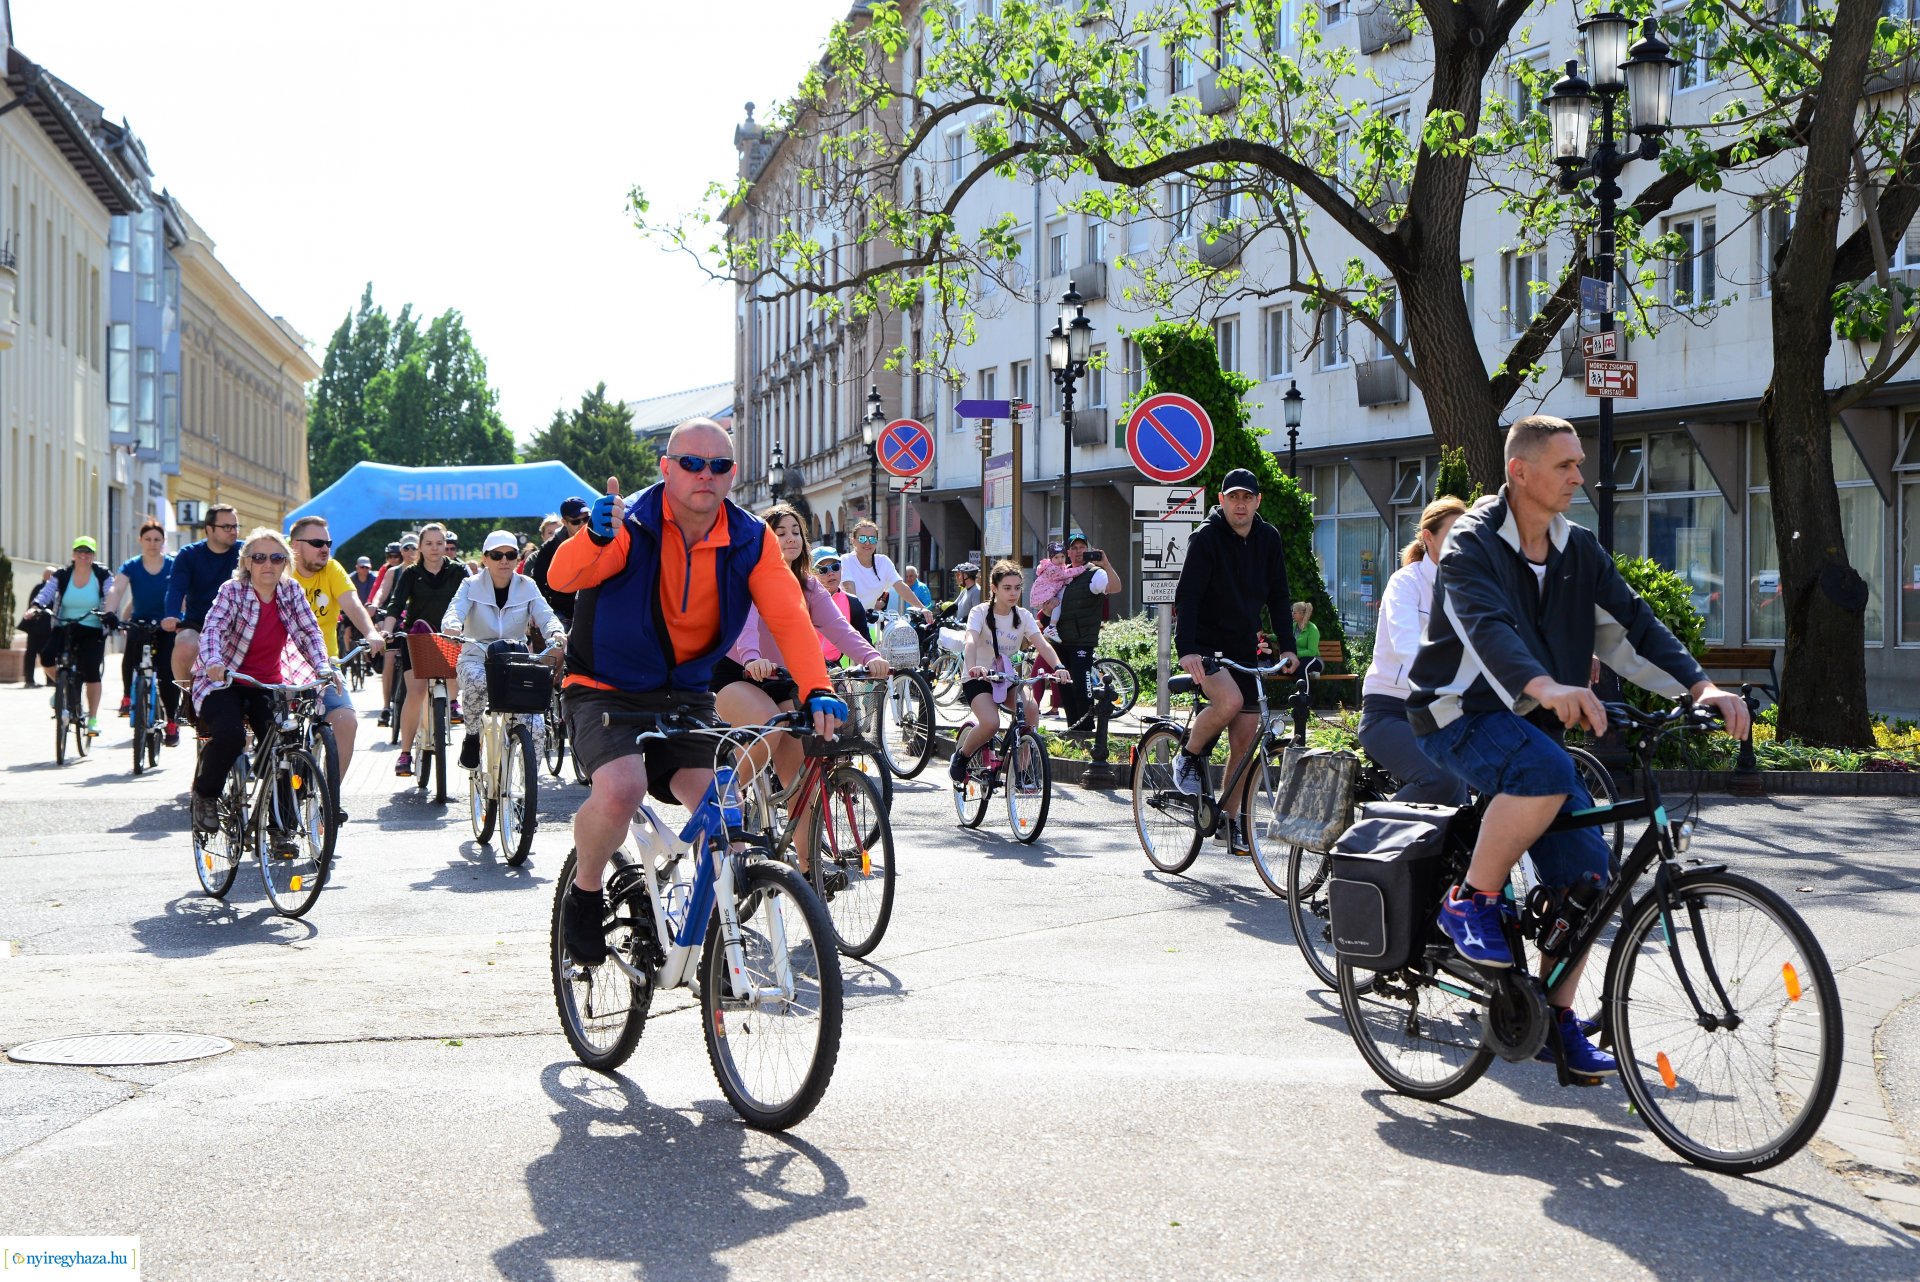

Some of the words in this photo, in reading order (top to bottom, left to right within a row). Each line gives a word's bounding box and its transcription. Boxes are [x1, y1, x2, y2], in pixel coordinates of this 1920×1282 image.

[1609, 363, 1634, 371] ZSIGMOND
[398, 481, 519, 502] SHIMANO
[1151, 587, 1175, 595] ÚTKEZE
[1147, 594, 1175, 602] ENGEDÉL
[1085, 670, 1093, 698] umbro
